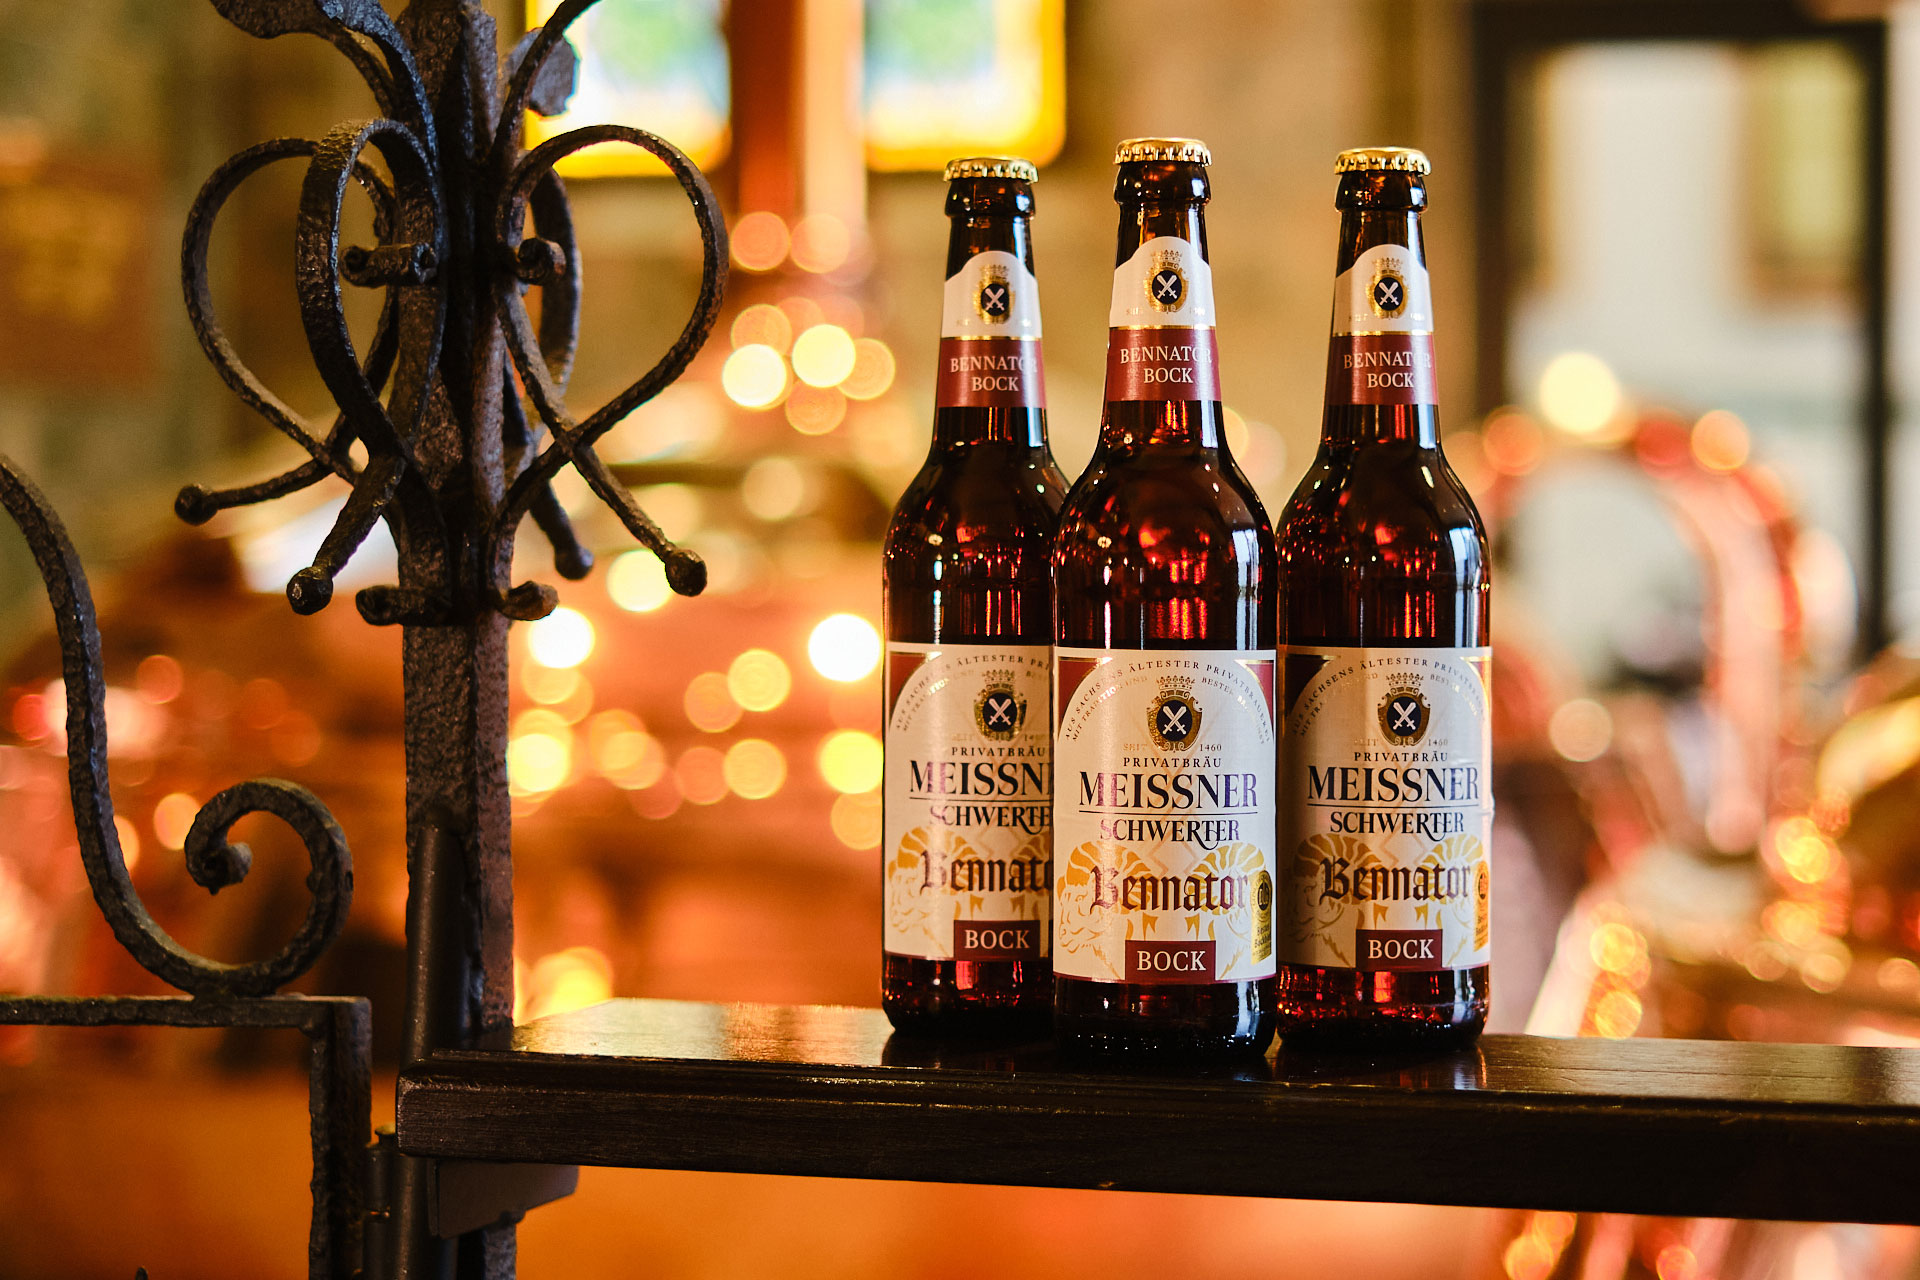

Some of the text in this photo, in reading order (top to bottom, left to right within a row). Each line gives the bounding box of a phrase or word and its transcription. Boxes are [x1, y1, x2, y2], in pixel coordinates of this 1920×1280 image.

[1120, 345, 1212, 364] BENNATOR
[1343, 351, 1431, 369] BENNATR
[971, 376, 1019, 392] BOCK
[1143, 367, 1194, 384] BOCK
[1367, 372, 1414, 389] BOCK
[956, 655, 1024, 668] ÄLTESTER
[1304, 666, 1354, 711] SACHSENS
[1360, 656, 1428, 670] ÄLTESTER
[1065, 717, 1075, 740] AUS
[1129, 660, 1199, 672] ÄLTESTER
[1072, 723, 1083, 742] MIT
[951, 746, 1046, 757] PRIVATBRÄU
[1123, 743, 1222, 752] SEIT 1460
[1354, 751, 1448, 762] PRIVATBRÄU
[1123, 756, 1222, 768] PRIVATBRÄU
[1079, 771, 1258, 810] MEISSNER
[1307, 765, 1479, 802] MEISSNER
[1100, 818, 1240, 850] SCHWERTER
[1330, 811, 1464, 842] SCHWERTER
[1090, 865, 1248, 915] Bennator
[1319, 856, 1471, 906] Bennator
[964, 929, 1030, 950] BOCK
[1368, 939, 1435, 959] BOCK
[1137, 950, 1206, 972] BOCK
